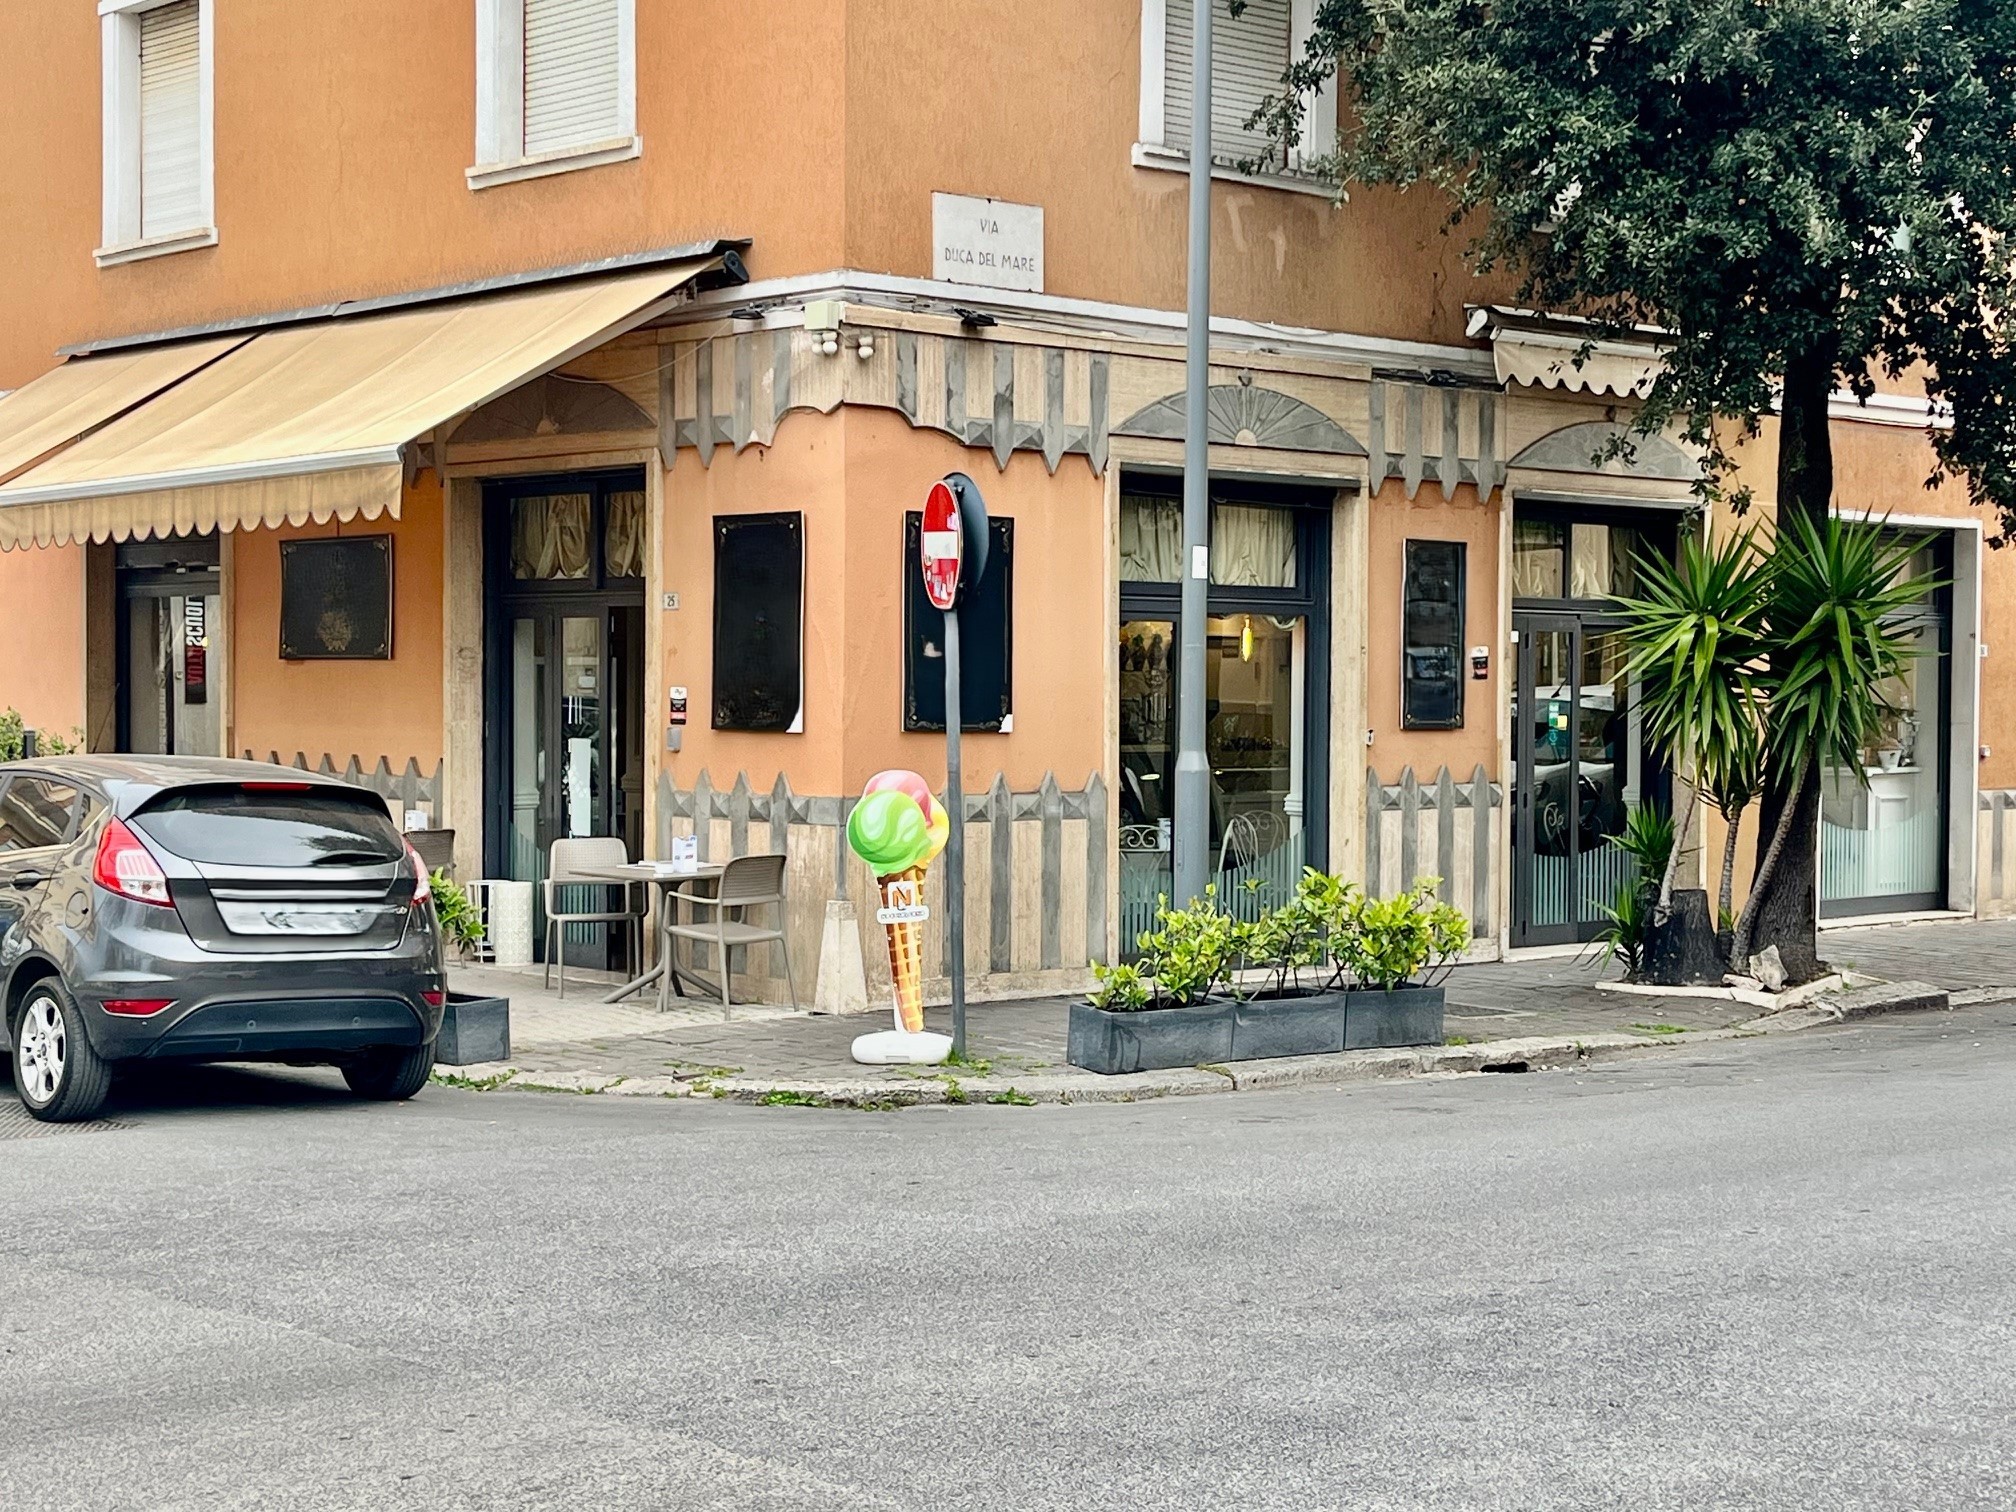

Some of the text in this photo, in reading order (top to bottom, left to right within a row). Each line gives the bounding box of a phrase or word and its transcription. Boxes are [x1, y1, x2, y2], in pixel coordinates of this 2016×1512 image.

[980, 218, 999, 234] VIA
[944, 247, 1035, 273] DUCA DEL MARE
